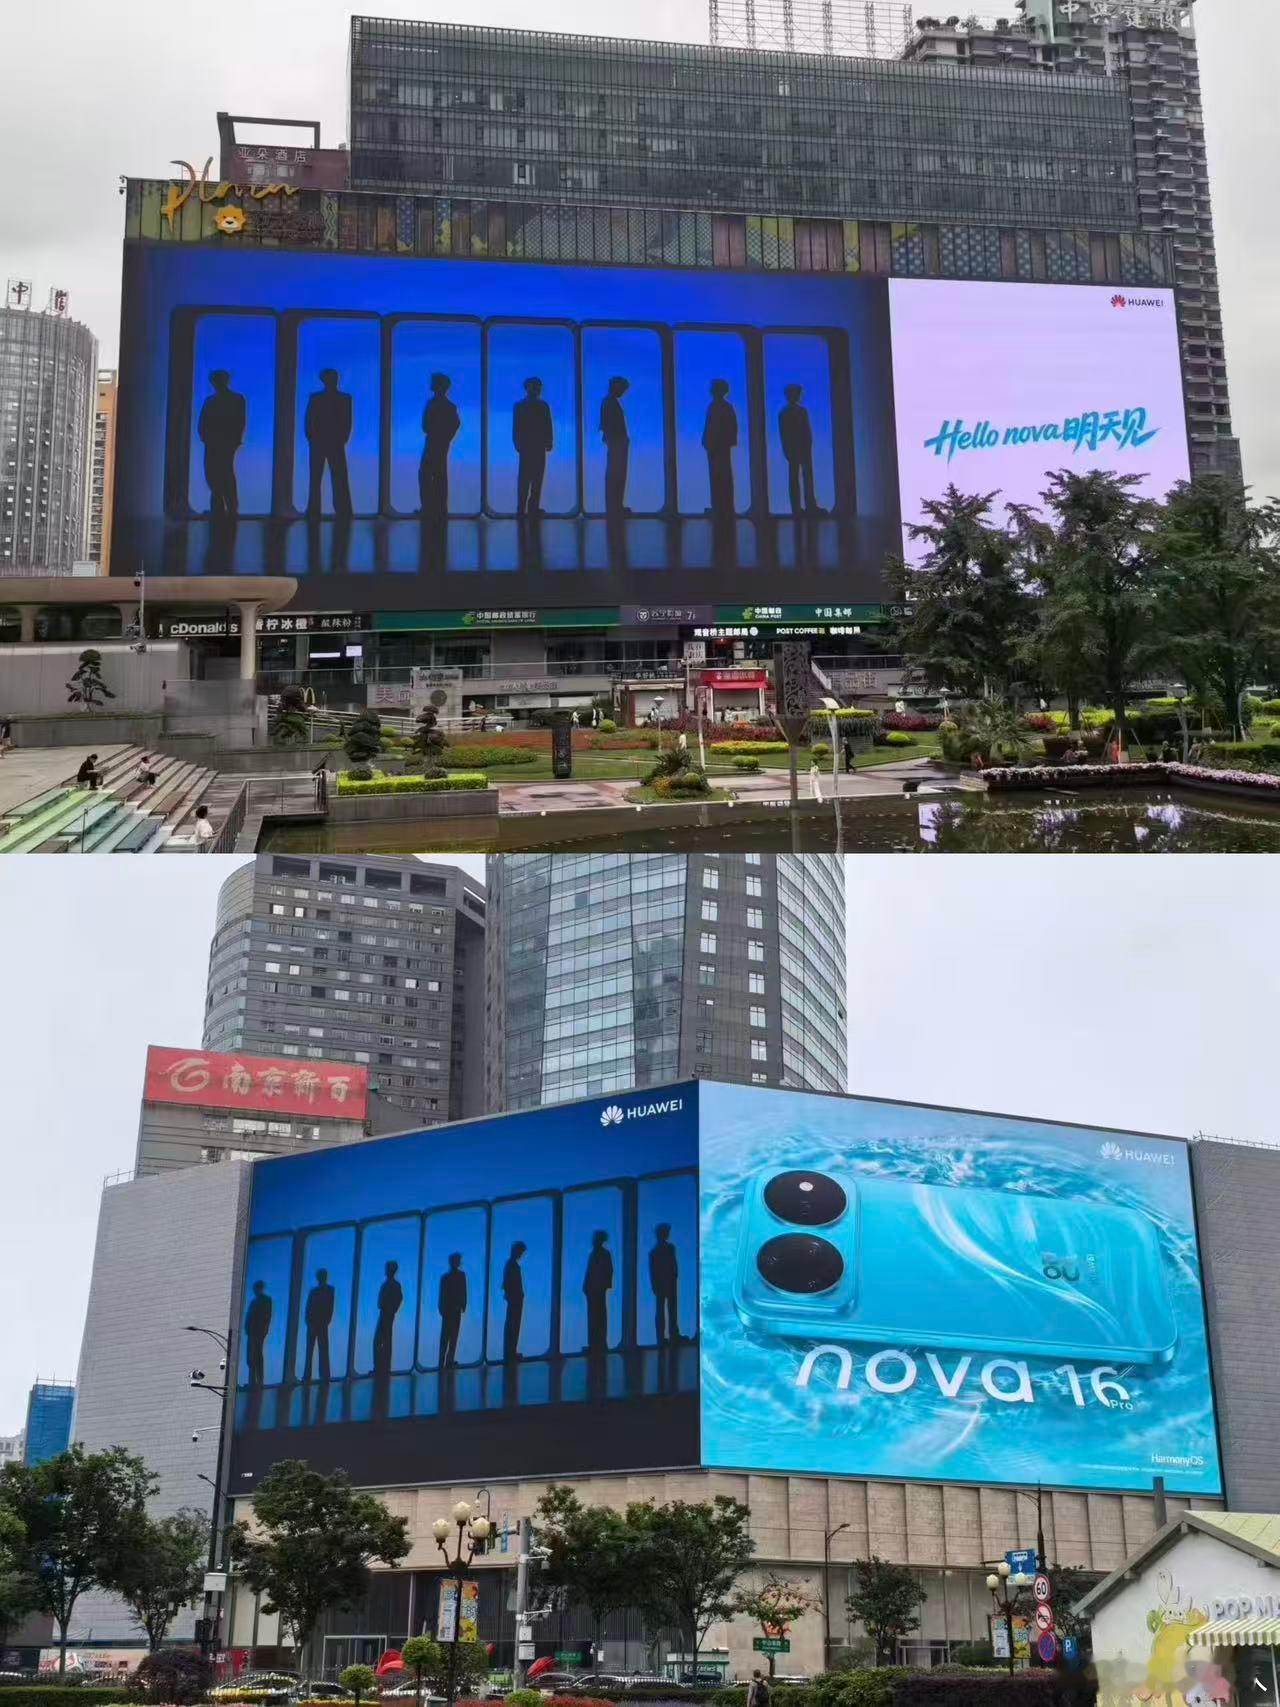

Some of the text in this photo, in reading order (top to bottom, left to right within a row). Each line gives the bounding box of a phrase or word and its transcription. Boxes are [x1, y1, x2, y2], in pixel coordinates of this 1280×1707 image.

[239, 147, 306, 162] 亚朵酒店
[1128, 298, 1164, 307] HUAWEI
[924, 407, 1162, 464] Hello nova 明天见
[223, 1063, 351, 1104] 南京新百
[627, 1098, 683, 1119] HUAWEI
[1125, 1149, 1175, 1165] HUAWEI
[795, 1344, 1131, 1408] nova 16
[1110, 1400, 1134, 1411] Pro
[1151, 1453, 1204, 1467] HarmonyOS
[1036, 1582, 1048, 1596] 60
[1211, 1597, 1252, 1620] POP
